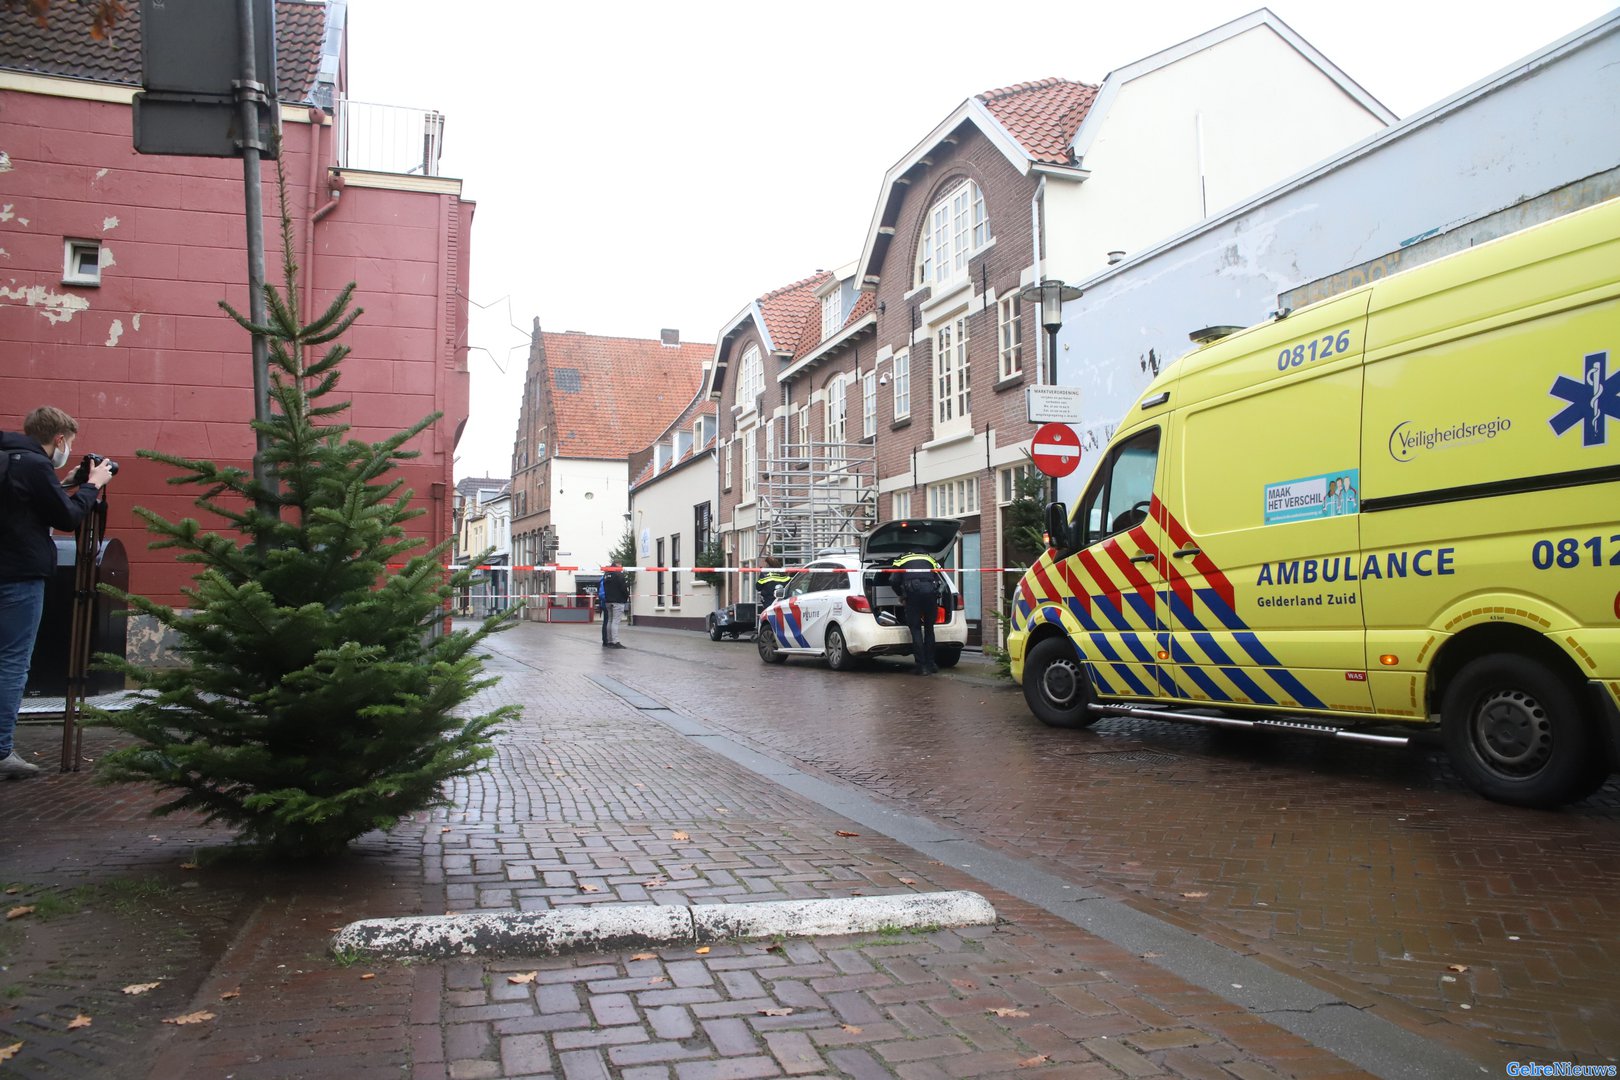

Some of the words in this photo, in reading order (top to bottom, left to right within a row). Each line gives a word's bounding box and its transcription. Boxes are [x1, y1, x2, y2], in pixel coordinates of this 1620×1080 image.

[1277, 329, 1350, 371] 08126
[1398, 416, 1511, 449] Veiligheidsregio
[1268, 486, 1291, 500] MAAK
[1268, 498, 1283, 511] HET
[1285, 493, 1323, 508] VERSCHIL
[1256, 547, 1455, 587] AMBULANCE
[1257, 594, 1323, 607] Gelderland
[1327, 592, 1357, 606] Zuid
